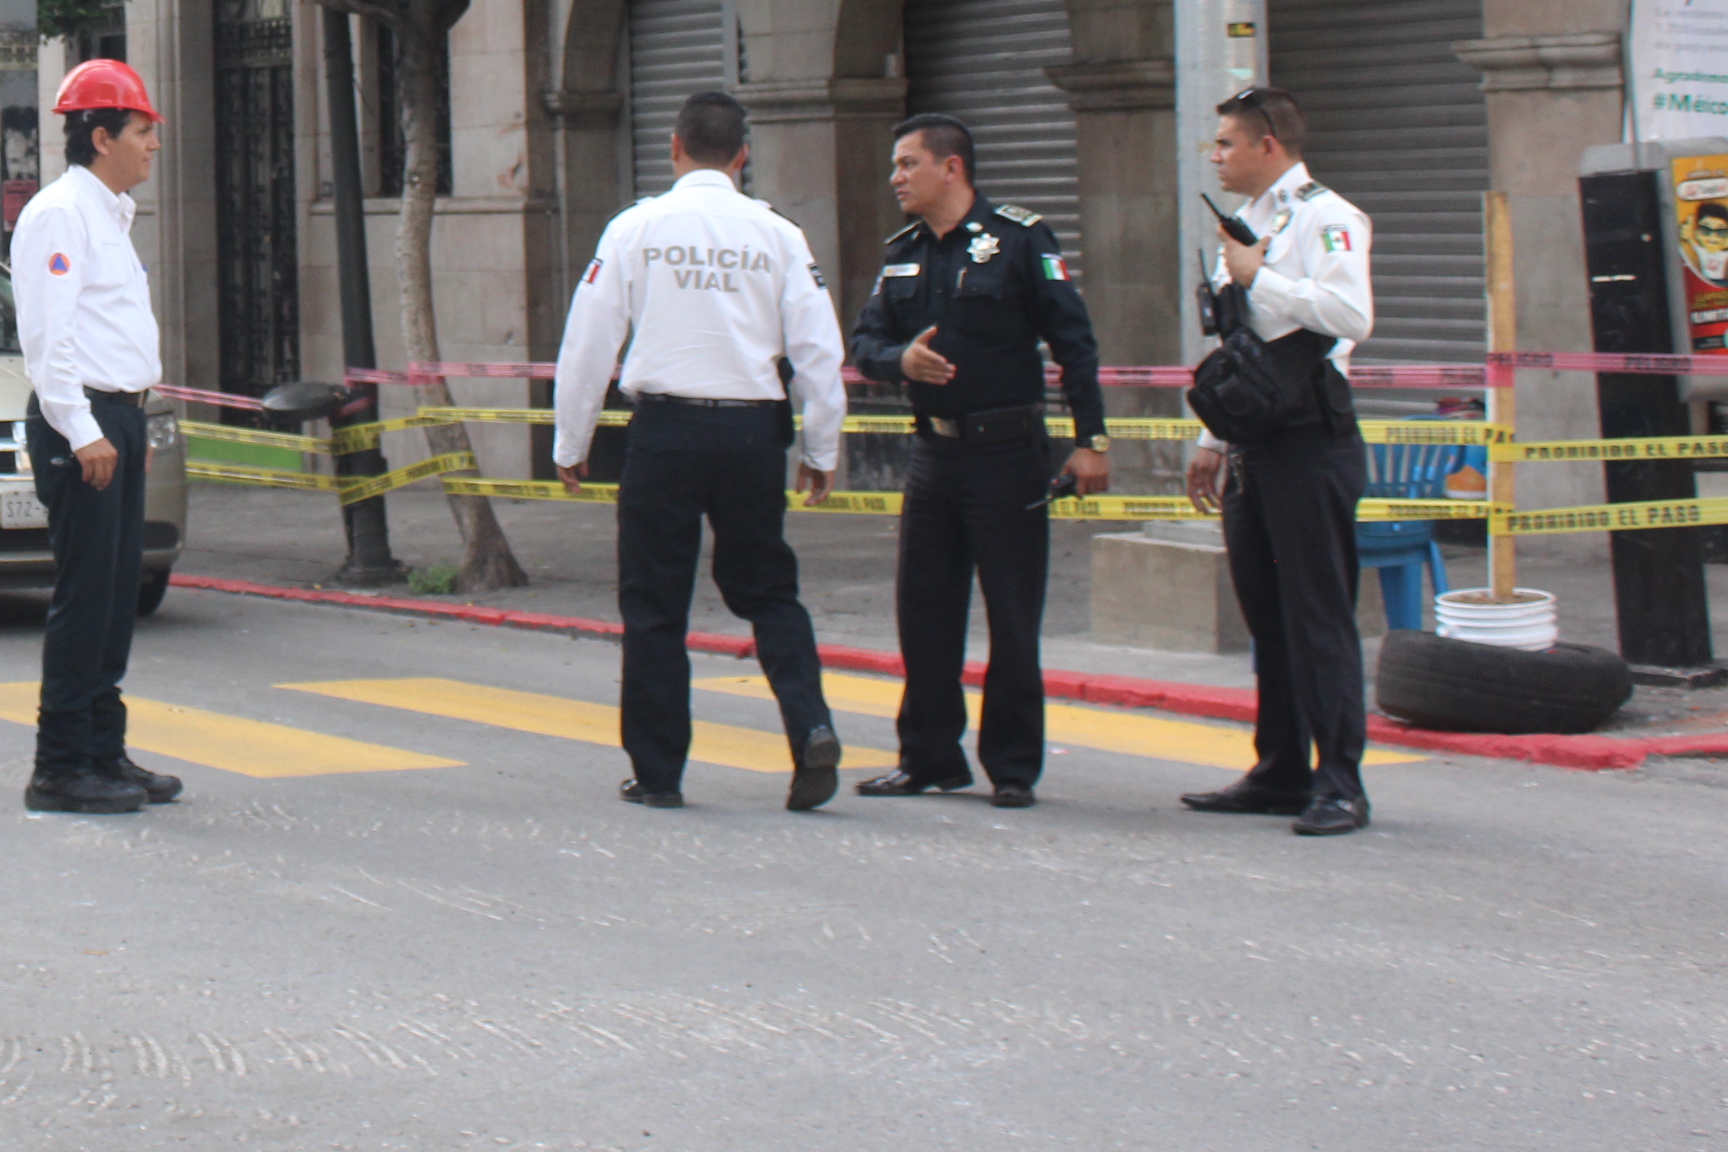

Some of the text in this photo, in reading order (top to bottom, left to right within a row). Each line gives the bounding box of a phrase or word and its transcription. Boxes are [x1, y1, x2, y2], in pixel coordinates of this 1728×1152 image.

[643, 245, 771, 274] POLICÍA
[674, 270, 740, 293] VIAL
[1525, 445, 1637, 460] PROHIBIDO
[1646, 443, 1668, 455] EL
[1507, 511, 1611, 531] PROHIBIDO
[1619, 509, 1639, 525] EL
[1647, 505, 1700, 524] PASO
